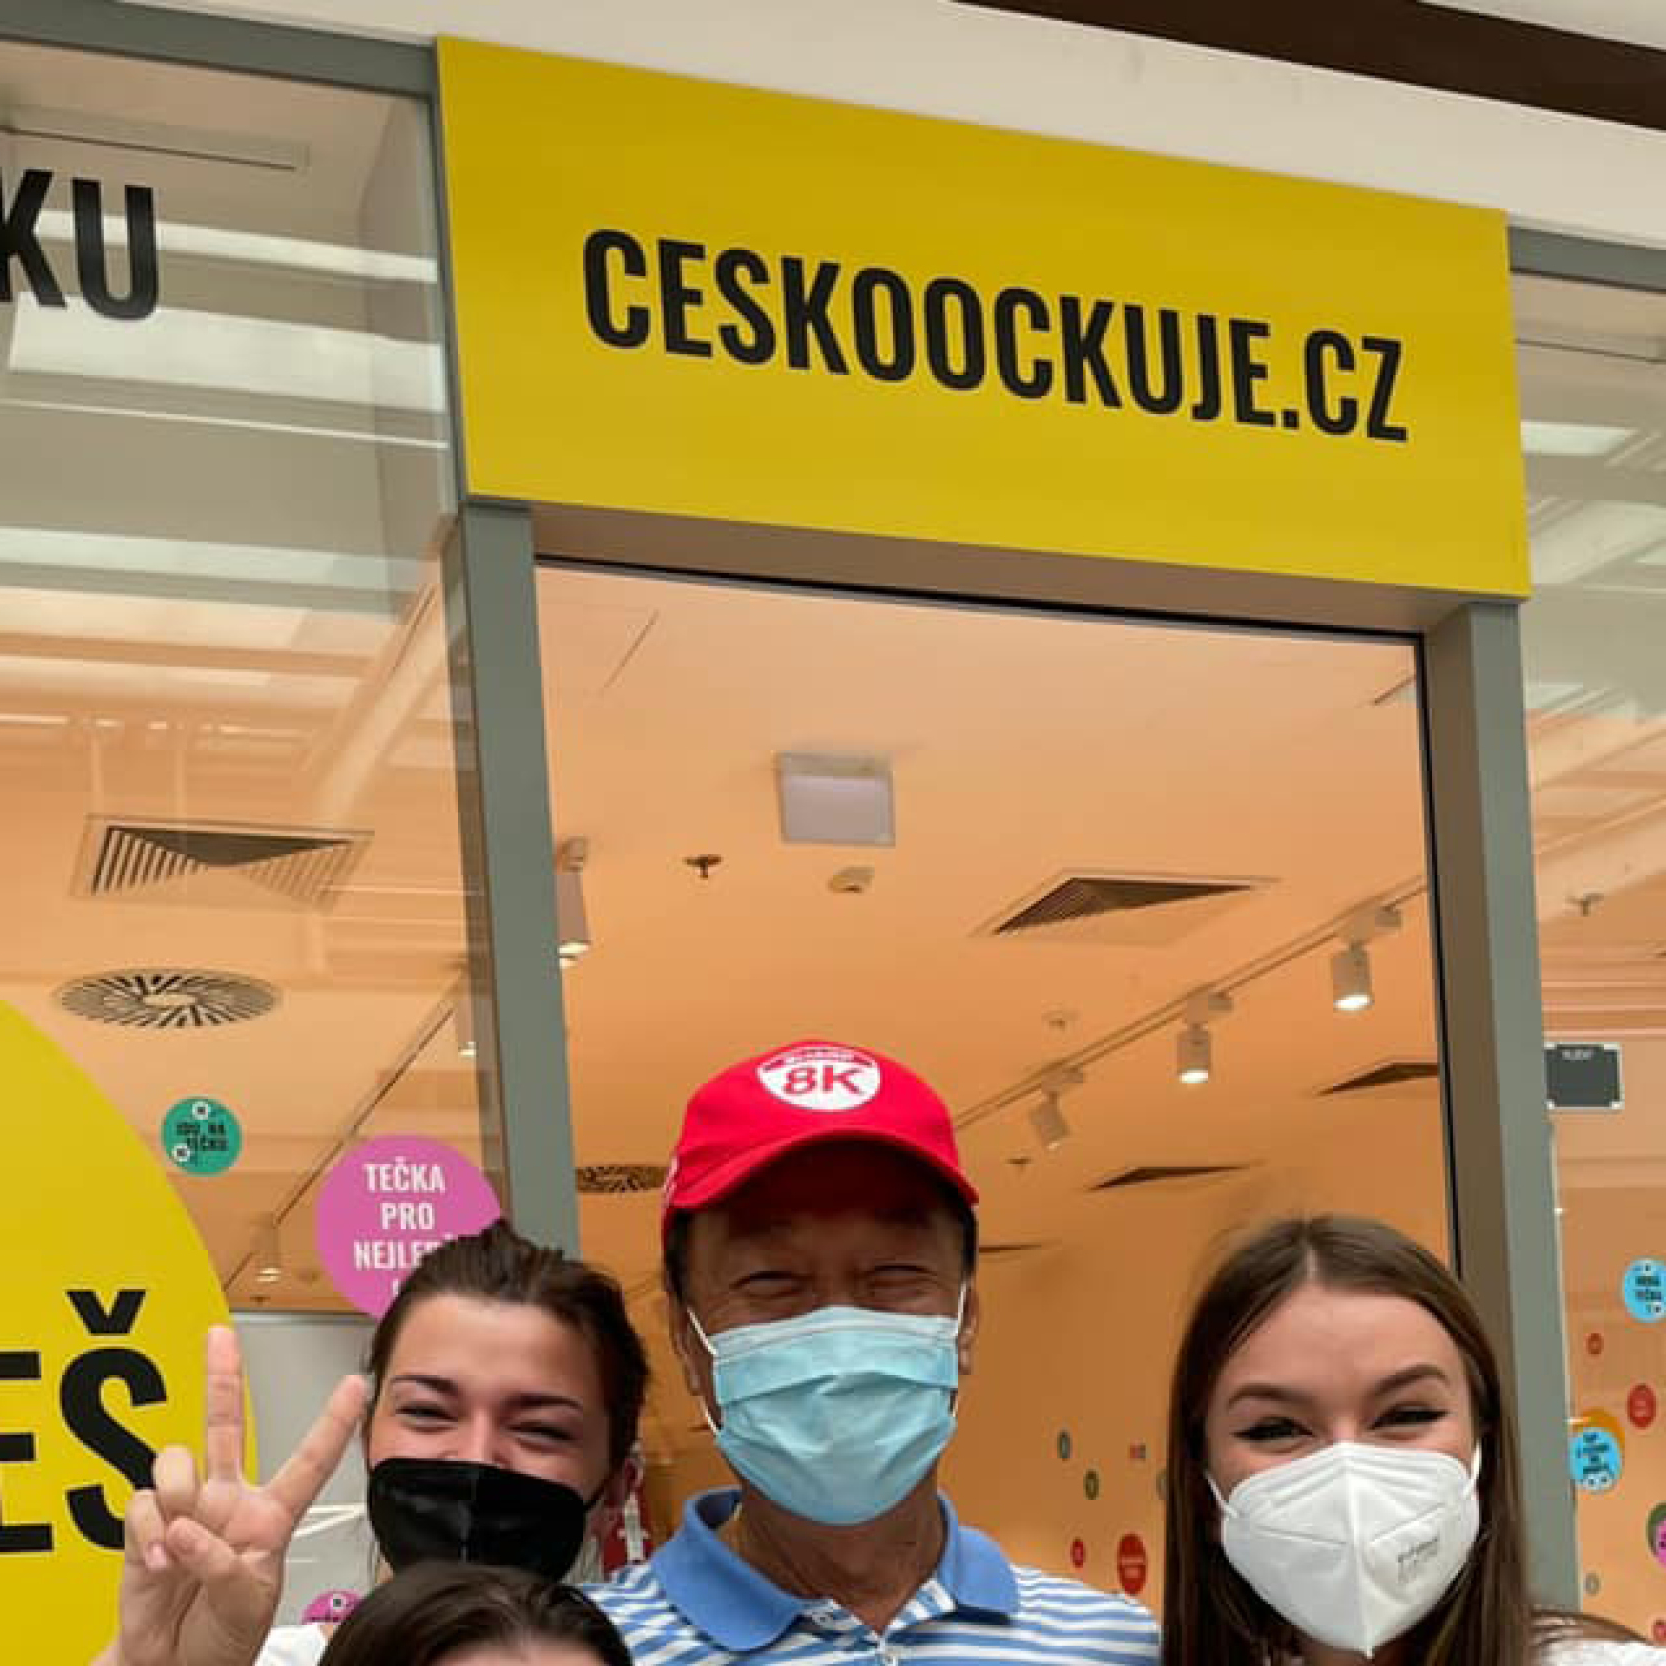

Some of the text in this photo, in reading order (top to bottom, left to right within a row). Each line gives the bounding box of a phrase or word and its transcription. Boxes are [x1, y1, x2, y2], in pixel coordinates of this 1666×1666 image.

[581, 228, 1408, 442] CESKOOCKUJE.CZ
[363, 1156, 447, 1193] TEČKA
[380, 1202, 435, 1230] PRO
[353, 1234, 453, 1270] NEJLE
